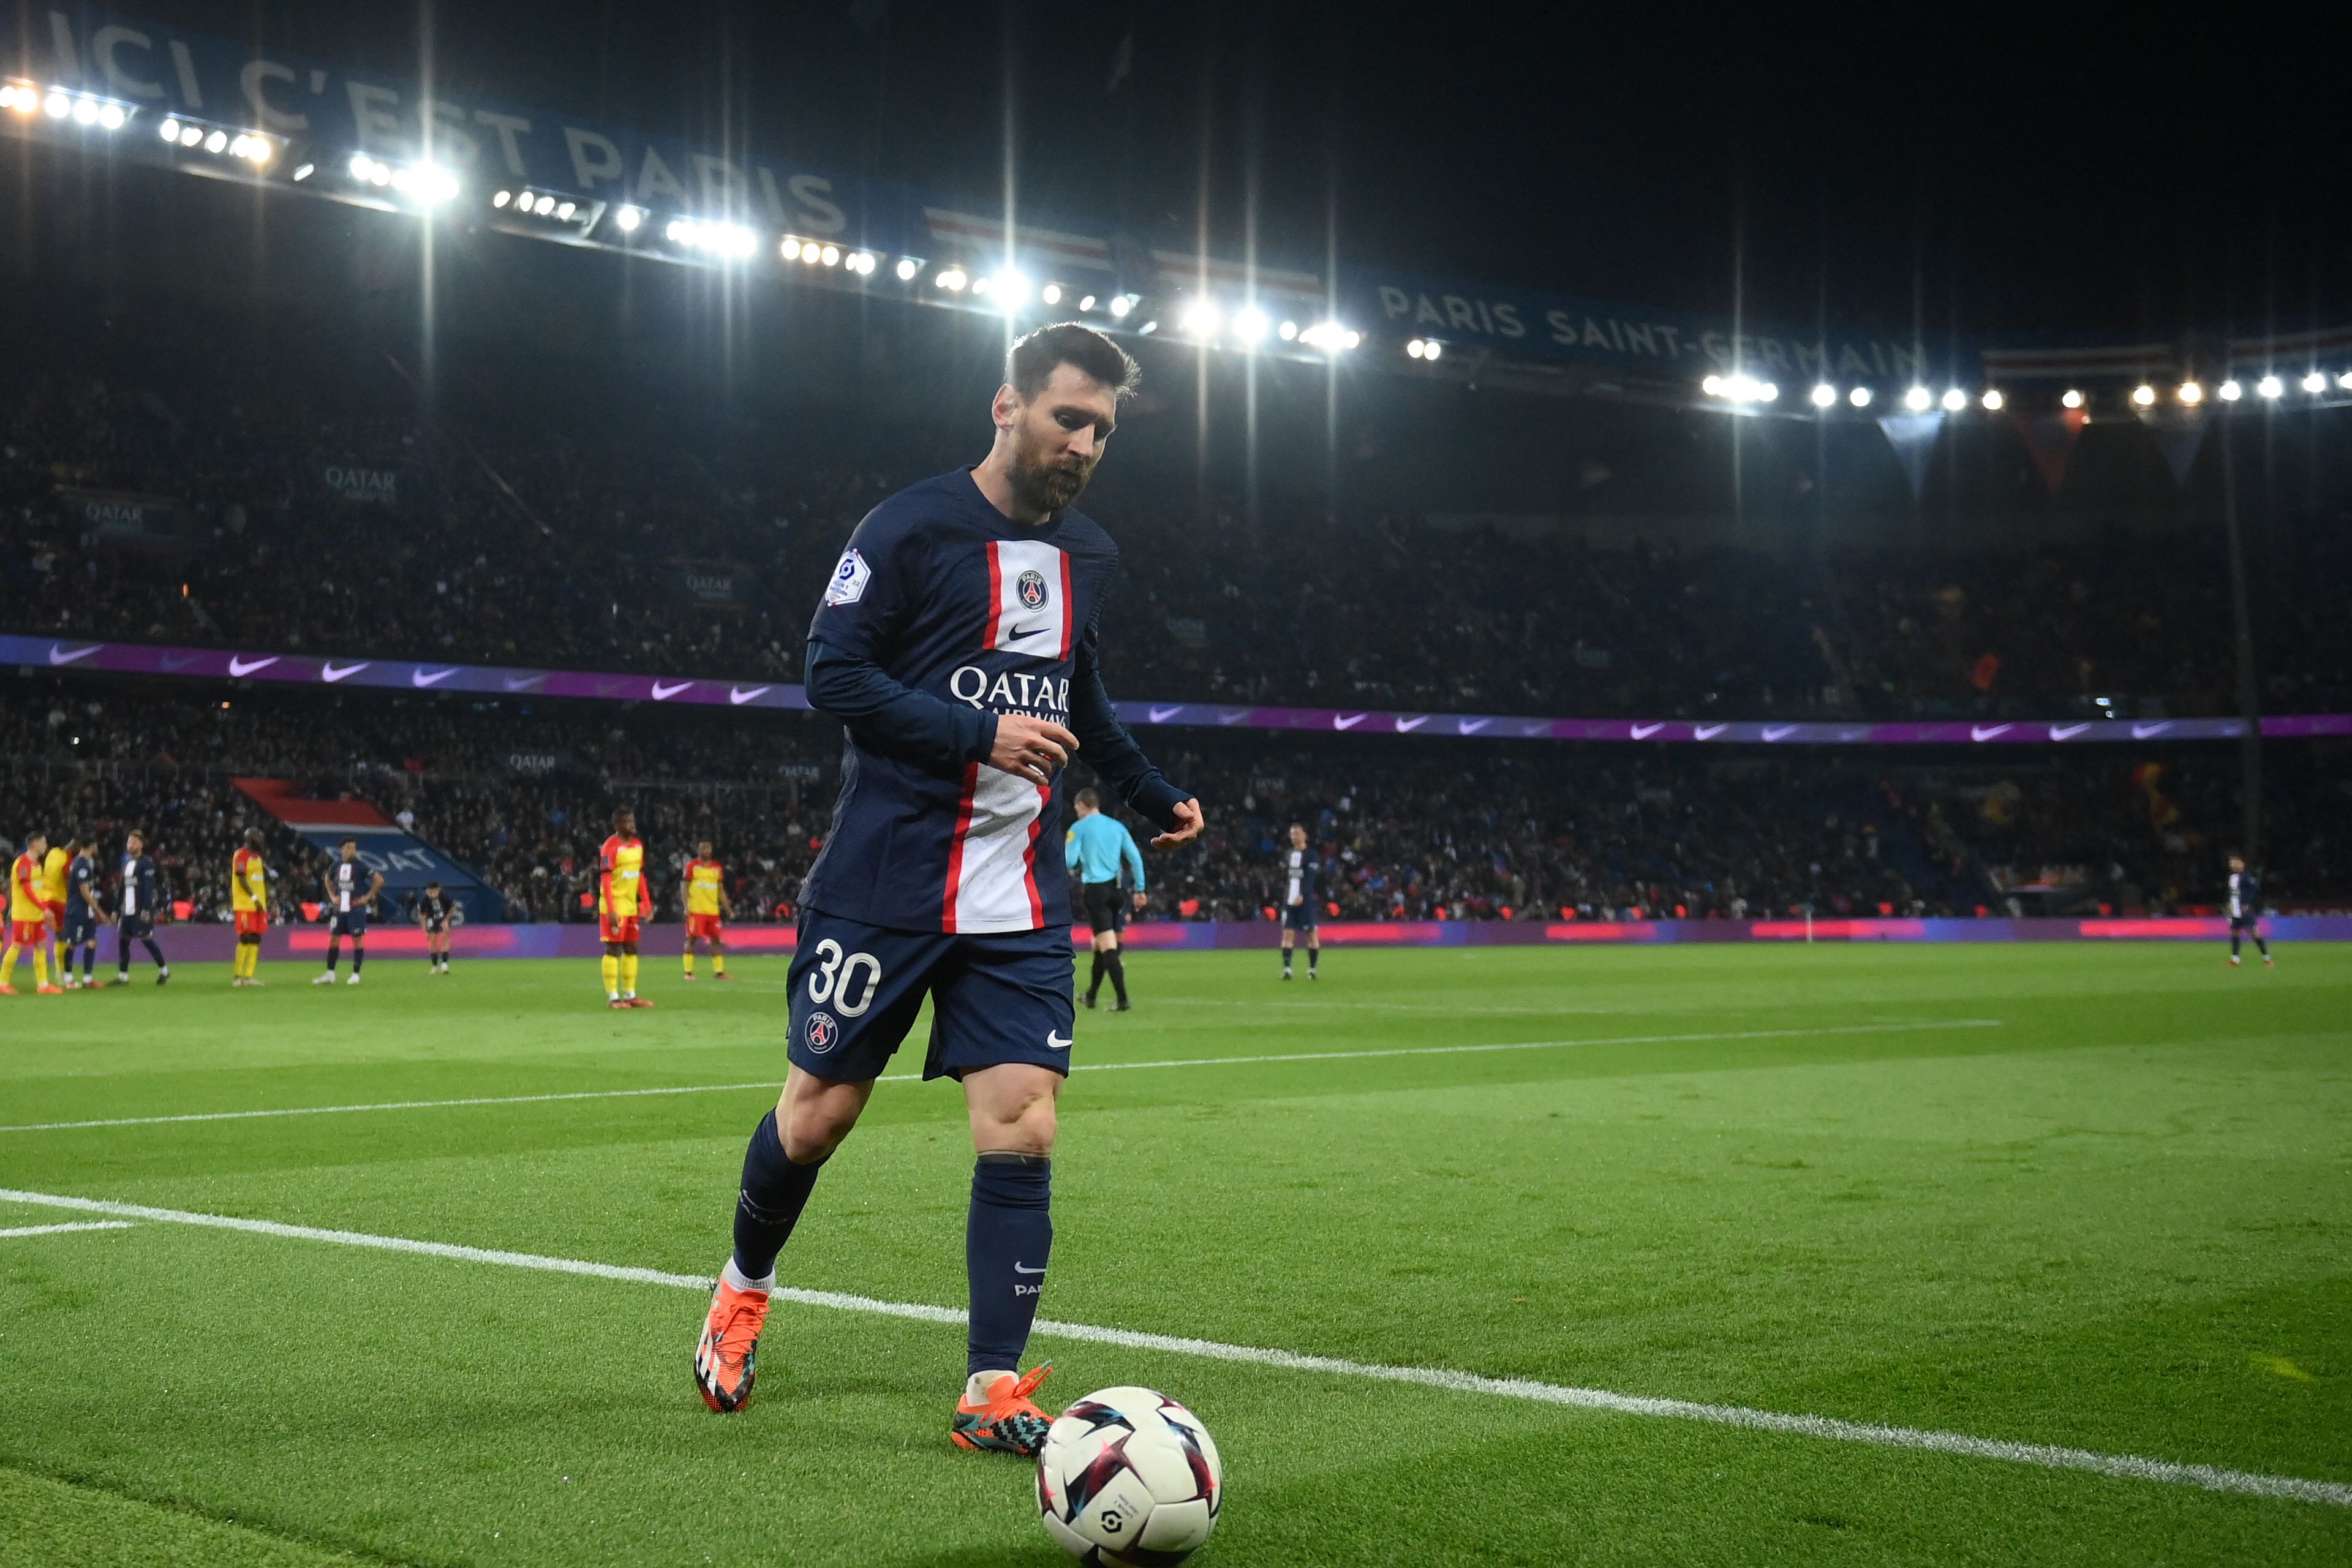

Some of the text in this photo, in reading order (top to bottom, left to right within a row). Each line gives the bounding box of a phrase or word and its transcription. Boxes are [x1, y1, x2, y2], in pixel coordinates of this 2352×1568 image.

[1378, 286, 1525, 339] PARIS
[325, 467, 397, 491] QATAR
[1022, 573, 1042, 585] PARIS
[950, 666, 1069, 712] QATAR
[808, 938, 881, 1017] 30
[813, 1014, 834, 1028] PARIS
